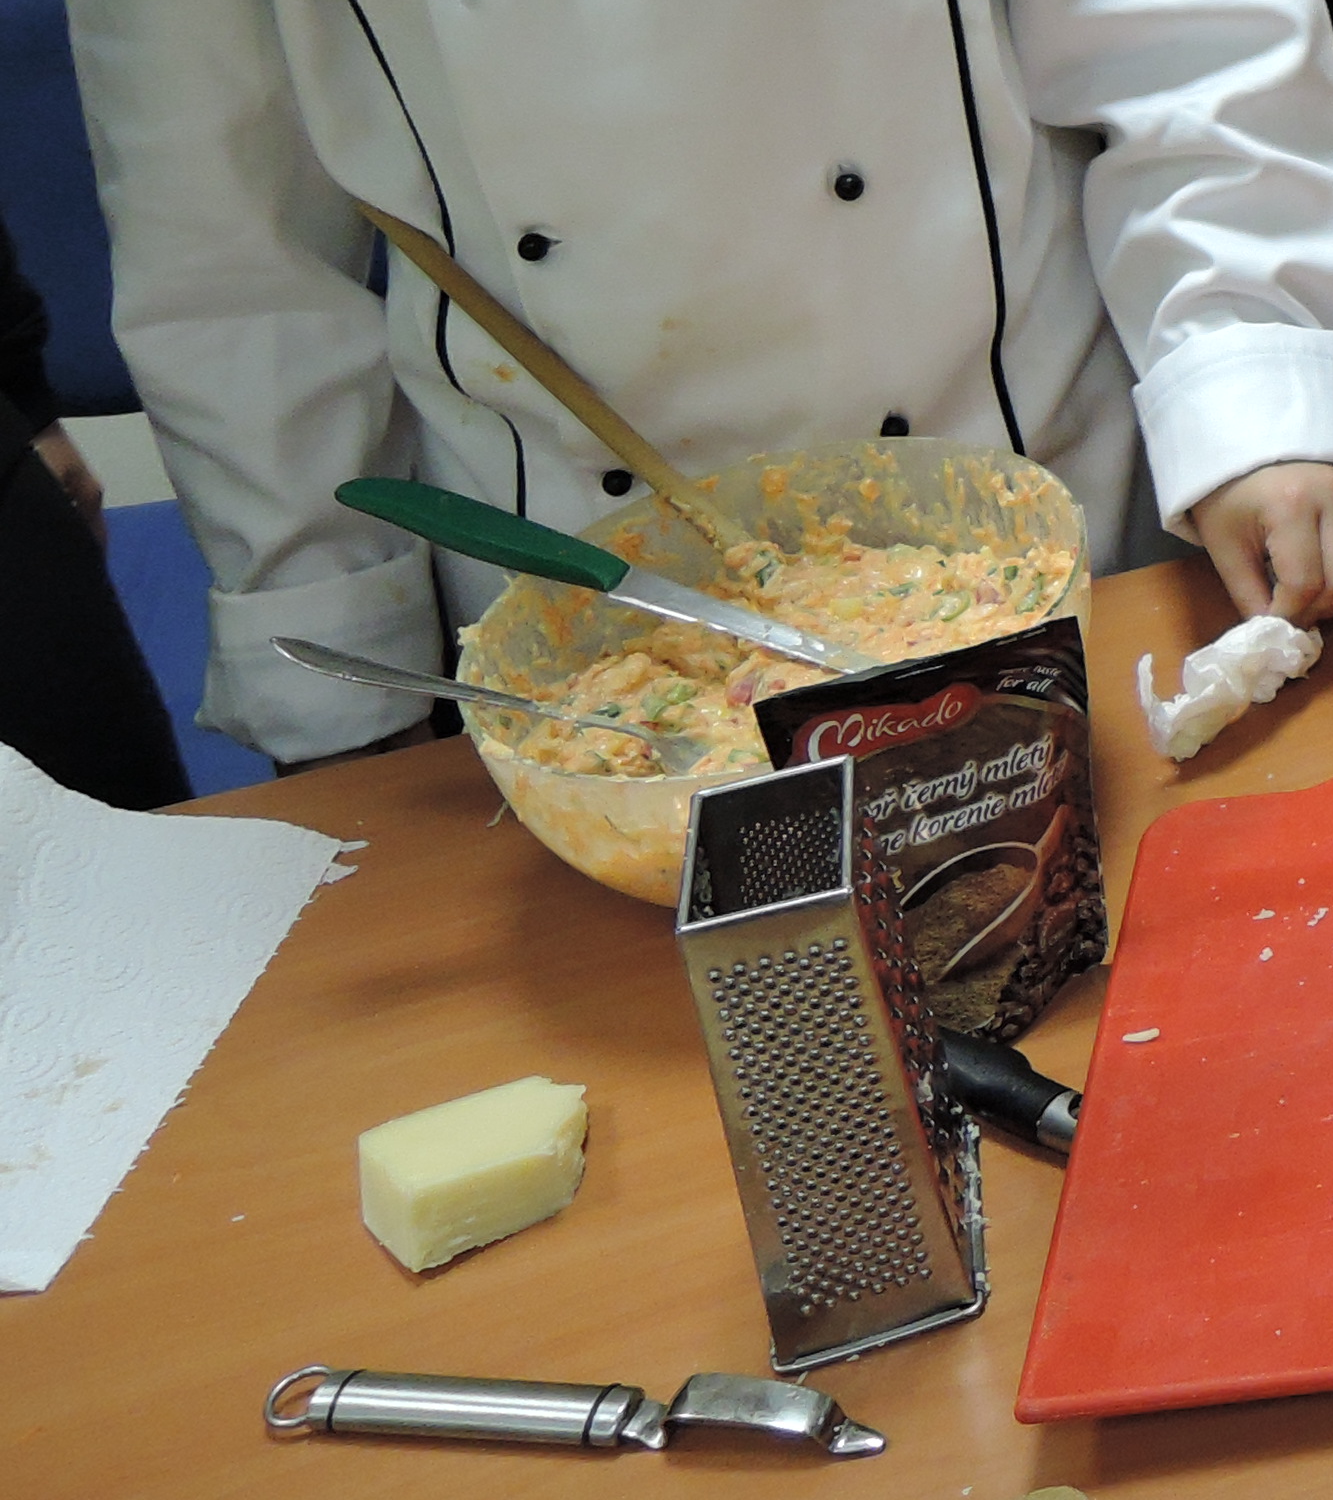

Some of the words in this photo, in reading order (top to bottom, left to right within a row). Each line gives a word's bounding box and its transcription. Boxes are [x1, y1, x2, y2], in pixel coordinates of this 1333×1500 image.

[996, 675, 1024, 691] for
[1026, 678, 1054, 692] all
[807, 693, 963, 762] Mikado
[984, 734, 1051, 782] mletý
[913, 795, 1004, 842] korenie
